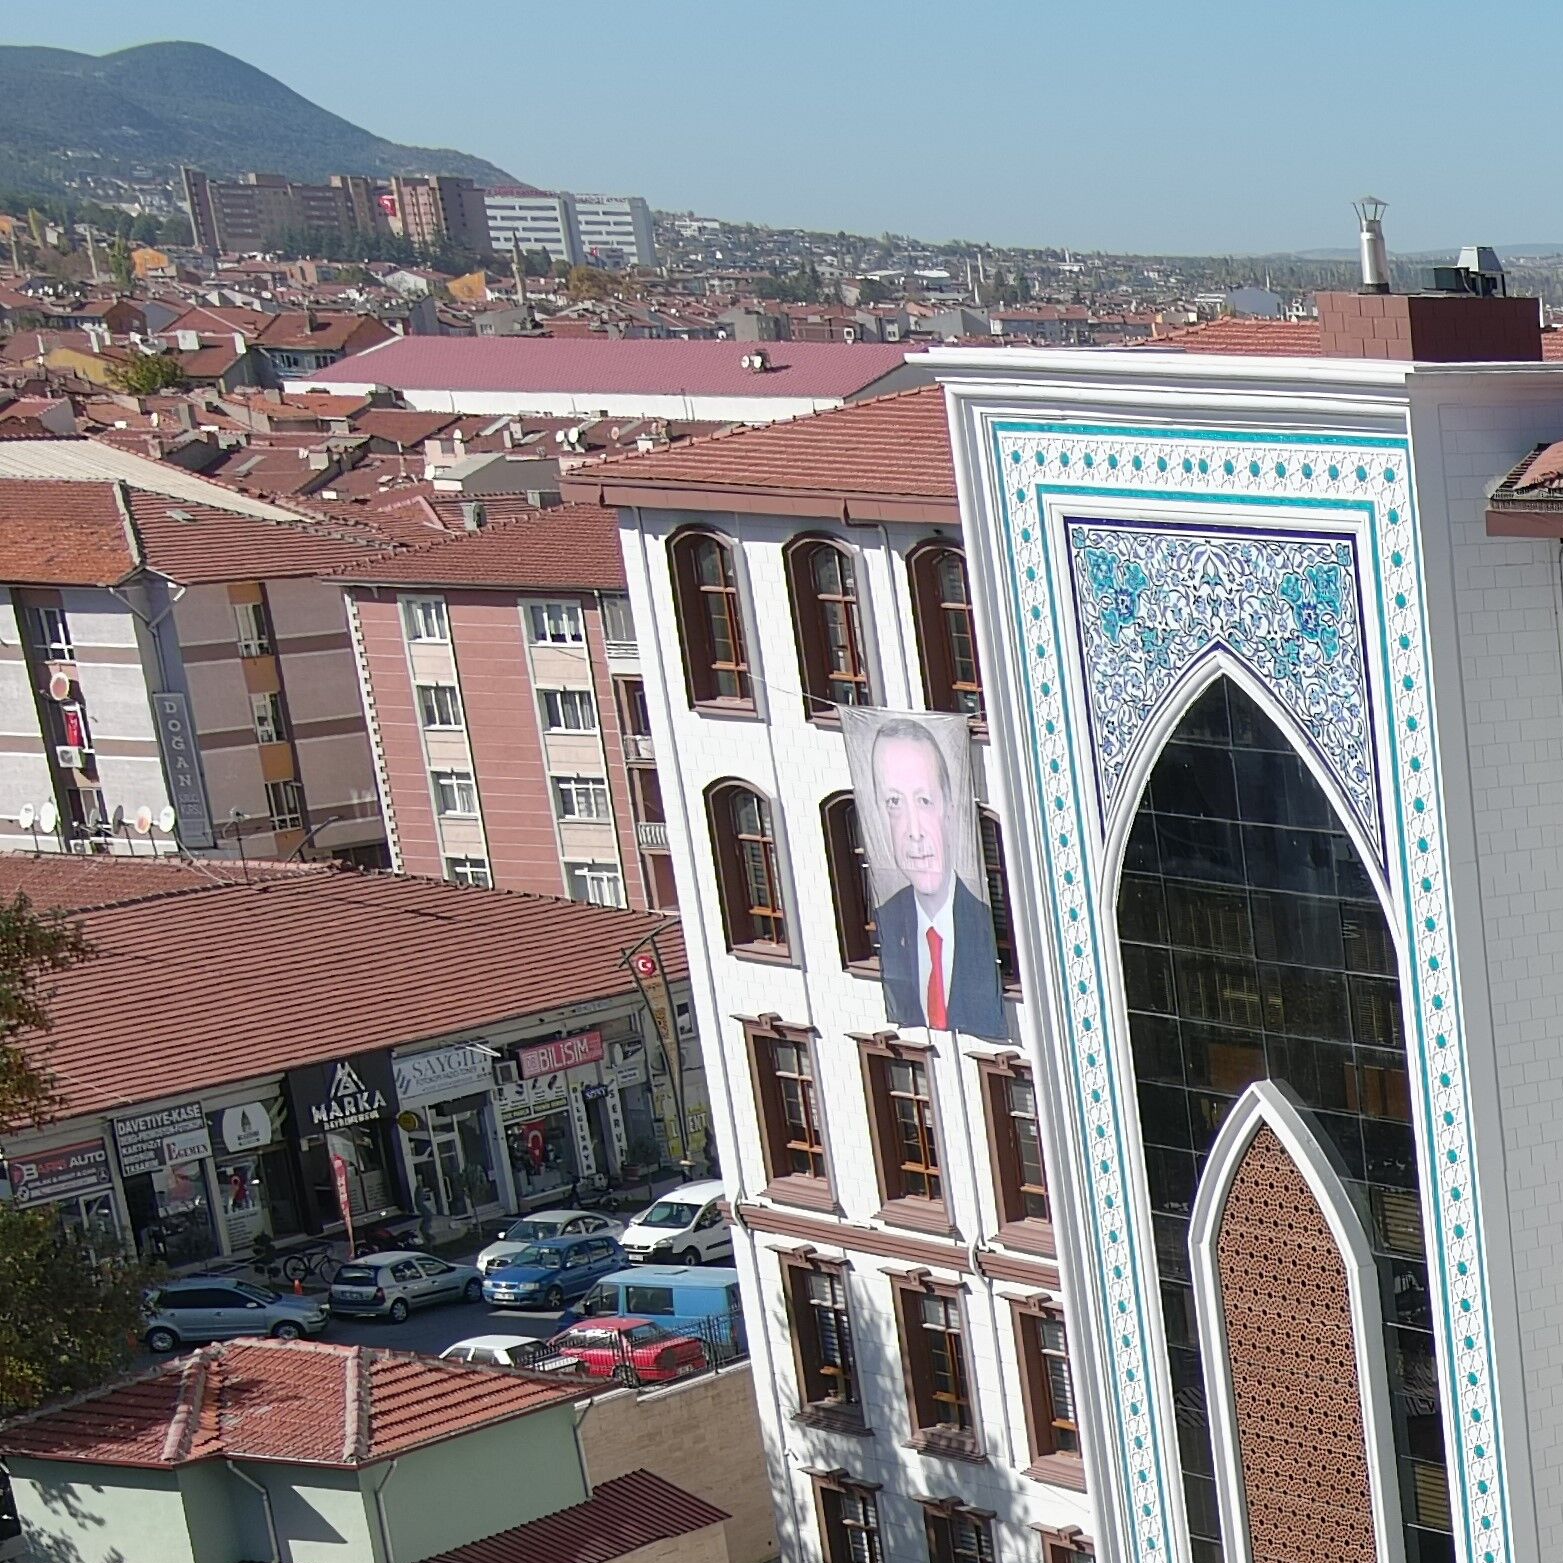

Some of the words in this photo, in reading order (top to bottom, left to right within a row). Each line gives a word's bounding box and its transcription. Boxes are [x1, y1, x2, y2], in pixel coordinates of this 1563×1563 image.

[164, 700, 193, 787] DOĞAN
[311, 1090, 387, 1124] MARKA
[69, 1150, 106, 1168] AUTO
